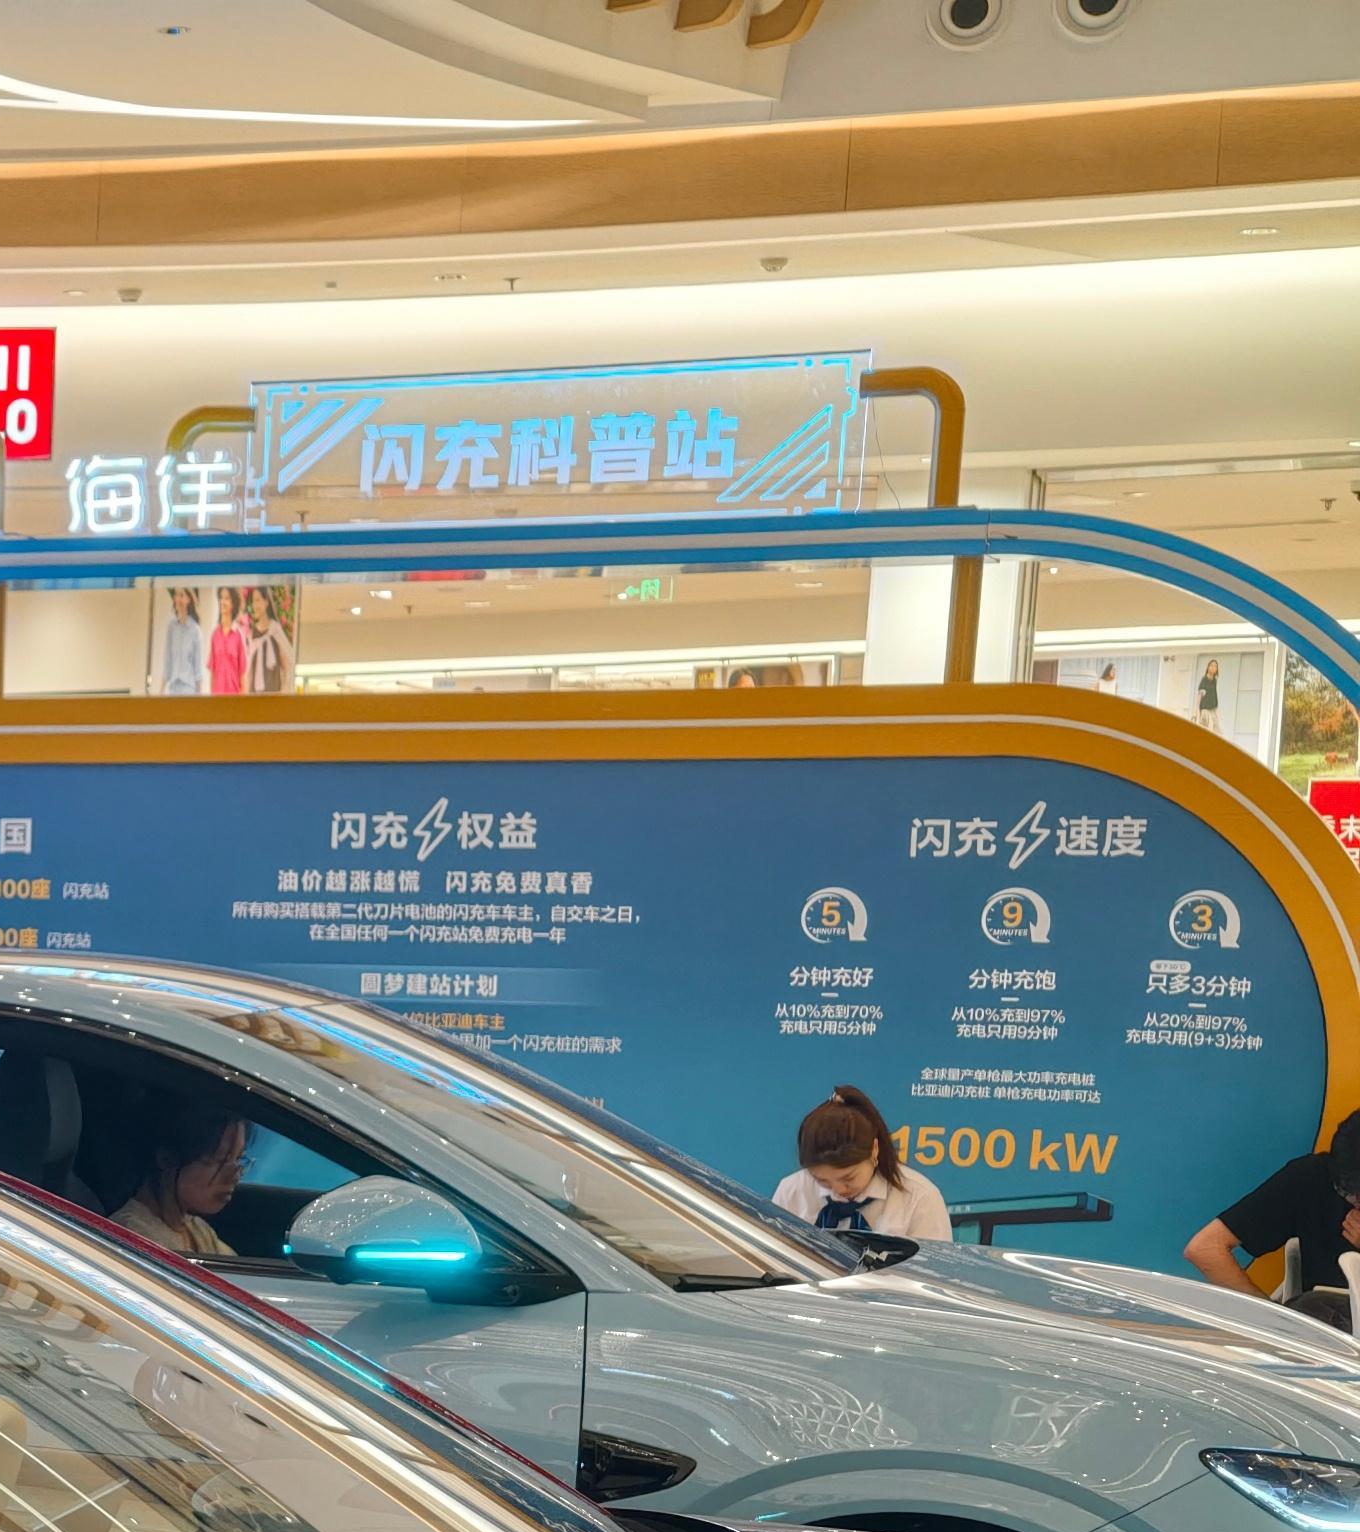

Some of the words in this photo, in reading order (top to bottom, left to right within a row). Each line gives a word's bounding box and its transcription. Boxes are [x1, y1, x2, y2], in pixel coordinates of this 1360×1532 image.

[359, 407, 739, 497] 闪充科普站
[67, 451, 237, 533] 海洋
[330, 811, 409, 850] 闪充
[457, 811, 537, 850] 权益
[909, 816, 998, 858] 闪充
[1055, 815, 1148, 857] 速度
[63, 882, 110, 900] 闪充站
[278, 870, 421, 894] 油价越涨越慌
[446, 870, 594, 895] 闪充免费真香
[821, 901, 841, 927] 5
[1003, 901, 1023, 928] 9
[1191, 905, 1213, 932] 3
[47, 931, 92, 948] 闪充站
[309, 925, 566, 944] 在全国任何一个闪充站免费充电一年
[812, 927, 847, 936] MINUTES
[992, 928, 1029, 937] MINUTES
[1181, 932, 1217, 941] MINUTES
[361, 972, 498, 998] 圆梦建站计划
[789, 966, 874, 988] 分钟充好
[968, 968, 1057, 991] 分钟充饱
[1146, 973, 1251, 998] 只多3分钟
[401, 1011, 505, 1031] 位比亚迪车主
[775, 1003, 883, 1020] 从10%充到70%
[951, 1006, 1066, 1024] 从10%充到97%
[1143, 1011, 1247, 1032] 从20%到97%
[779, 1020, 877, 1036] 充电只用5分钟
[956, 1024, 1058, 1041] 充电只用9分钟
[1125, 1028, 1263, 1051] 充电只用(9+3)分钟
[921, 1067, 1095, 1087] 全球量产单枪最大功率充电桩
[911, 1083, 991, 1099] 比亚迪闪充桩
[994, 1086, 1101, 1104] 单枪充电功率可达
[891, 1125, 1016, 1169] 1500
[1030, 1128, 1119, 1175] kW
